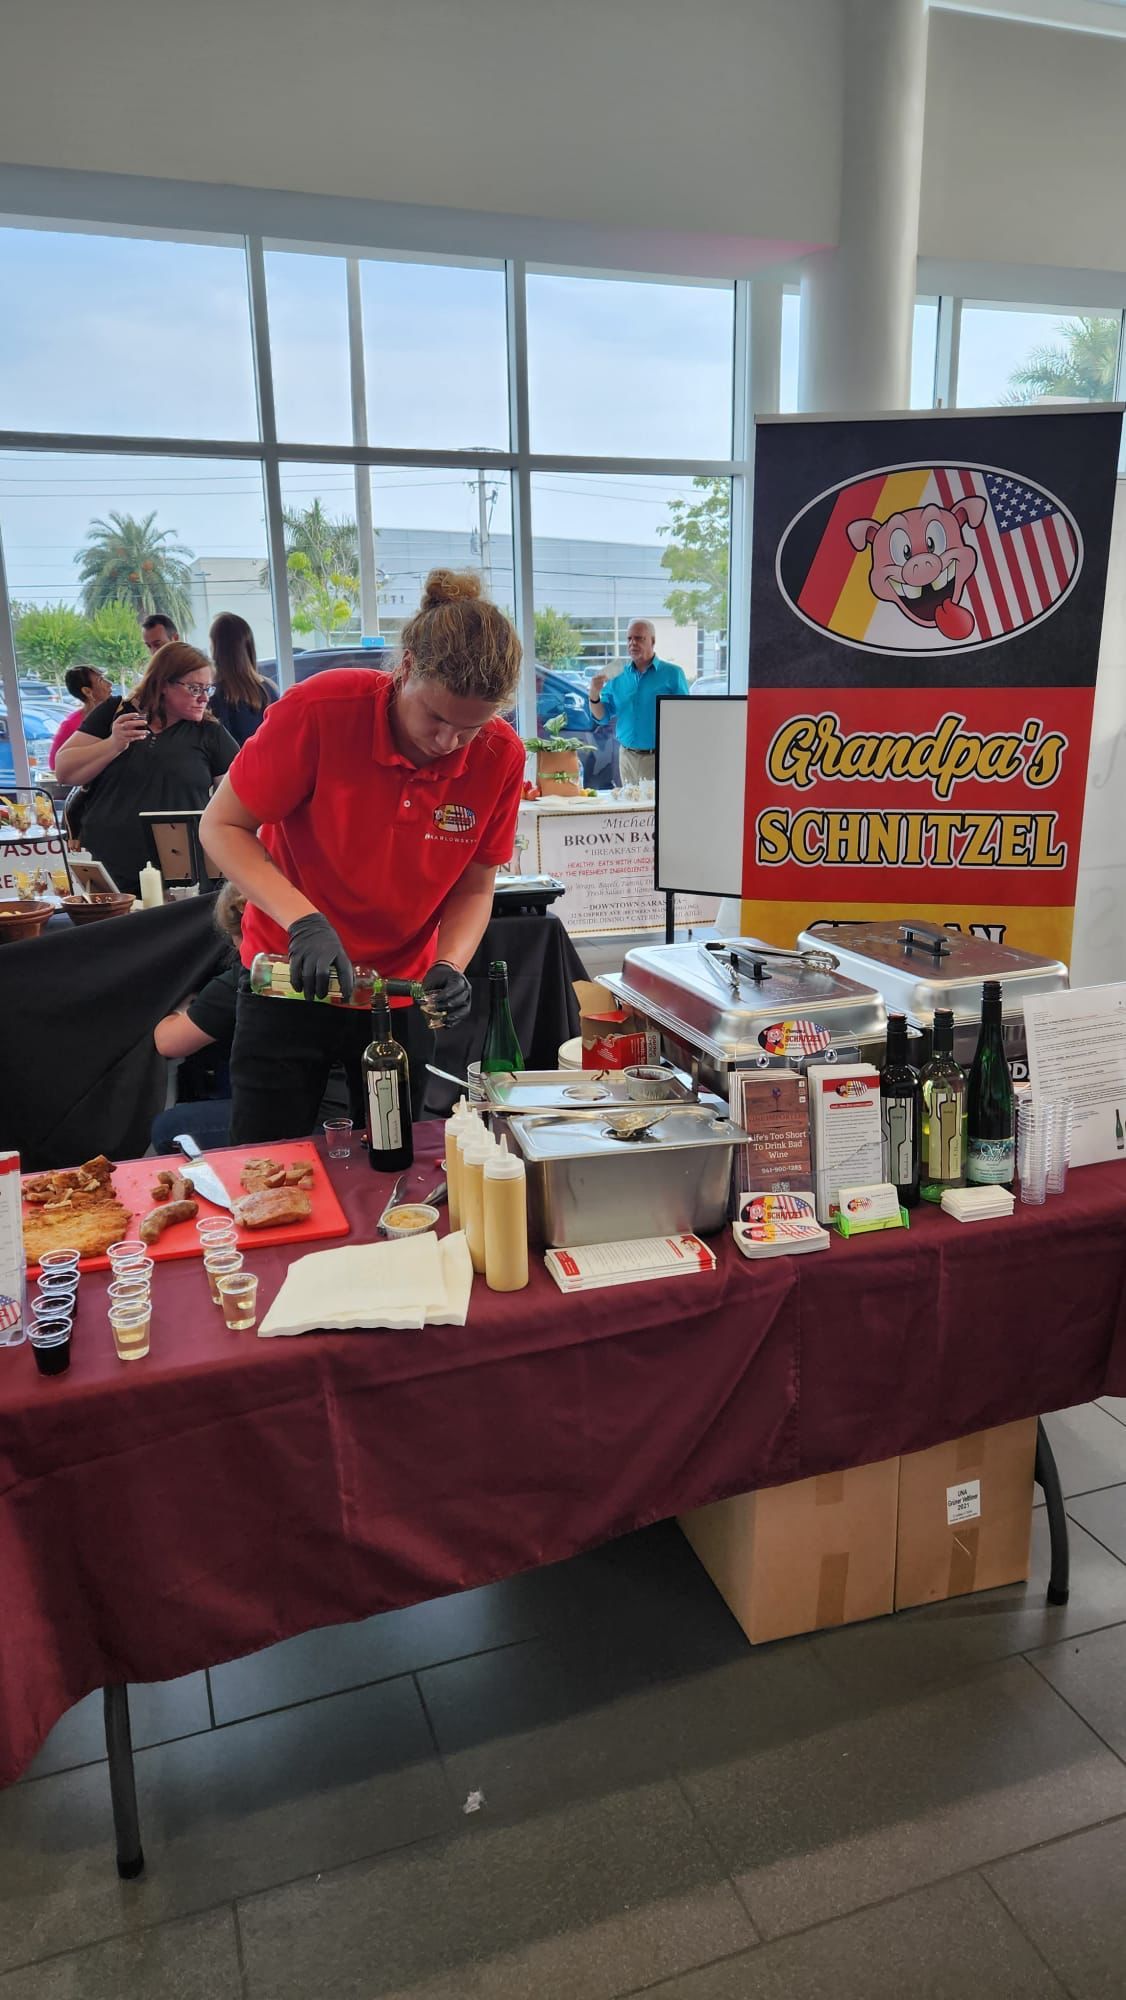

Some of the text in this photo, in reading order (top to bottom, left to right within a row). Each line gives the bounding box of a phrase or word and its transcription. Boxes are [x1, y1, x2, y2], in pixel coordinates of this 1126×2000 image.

[767, 713, 1068, 800] Grandpa's
[564, 832, 625, 847] BROWN
[756, 808, 1067, 869] SCHNITZEL
[591, 847, 642, 856] BREAKFAST
[598, 859, 613, 867] EATS
[769, 1132, 784, 1140] Too
[785, 1131, 806, 1139] Short
[753, 1140, 802, 1151] To Drink Bad
[768, 1151, 789, 1159] Wine
